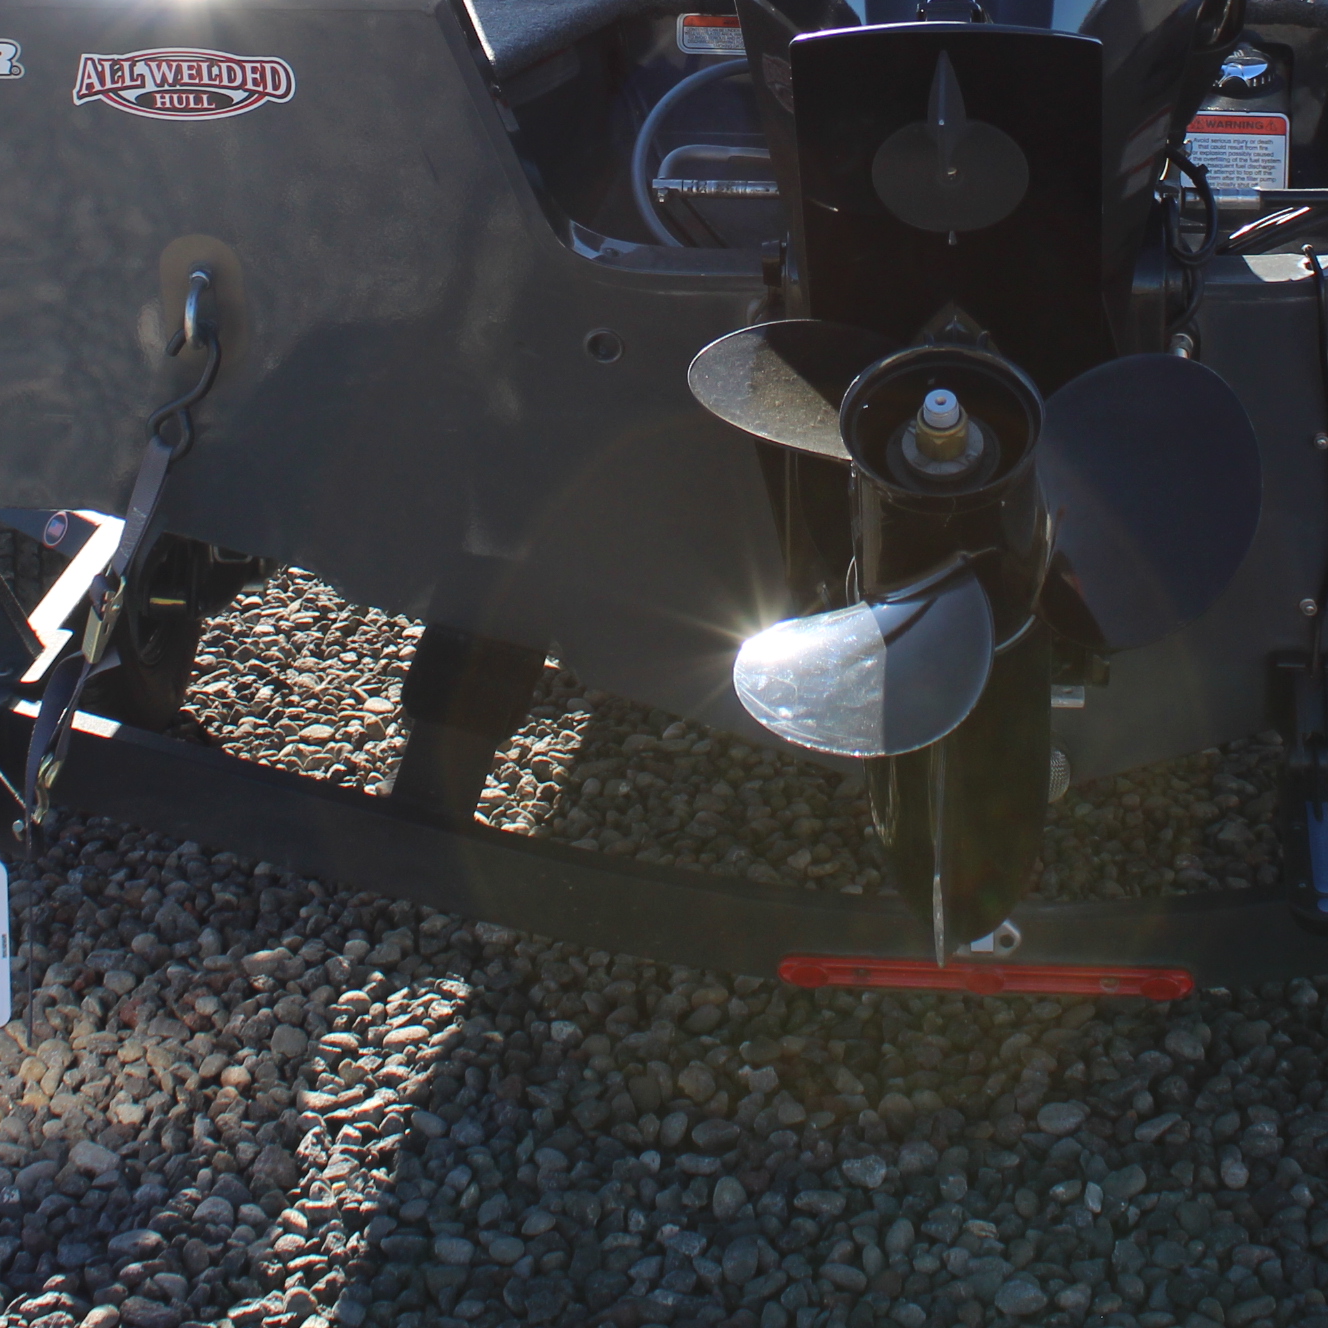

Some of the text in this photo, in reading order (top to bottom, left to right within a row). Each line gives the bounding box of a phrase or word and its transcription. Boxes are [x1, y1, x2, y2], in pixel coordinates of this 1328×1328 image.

[147, 59, 288, 96] WELDED
[154, 92, 216, 108] HULL
[1206, 118, 1264, 130] WARNING
